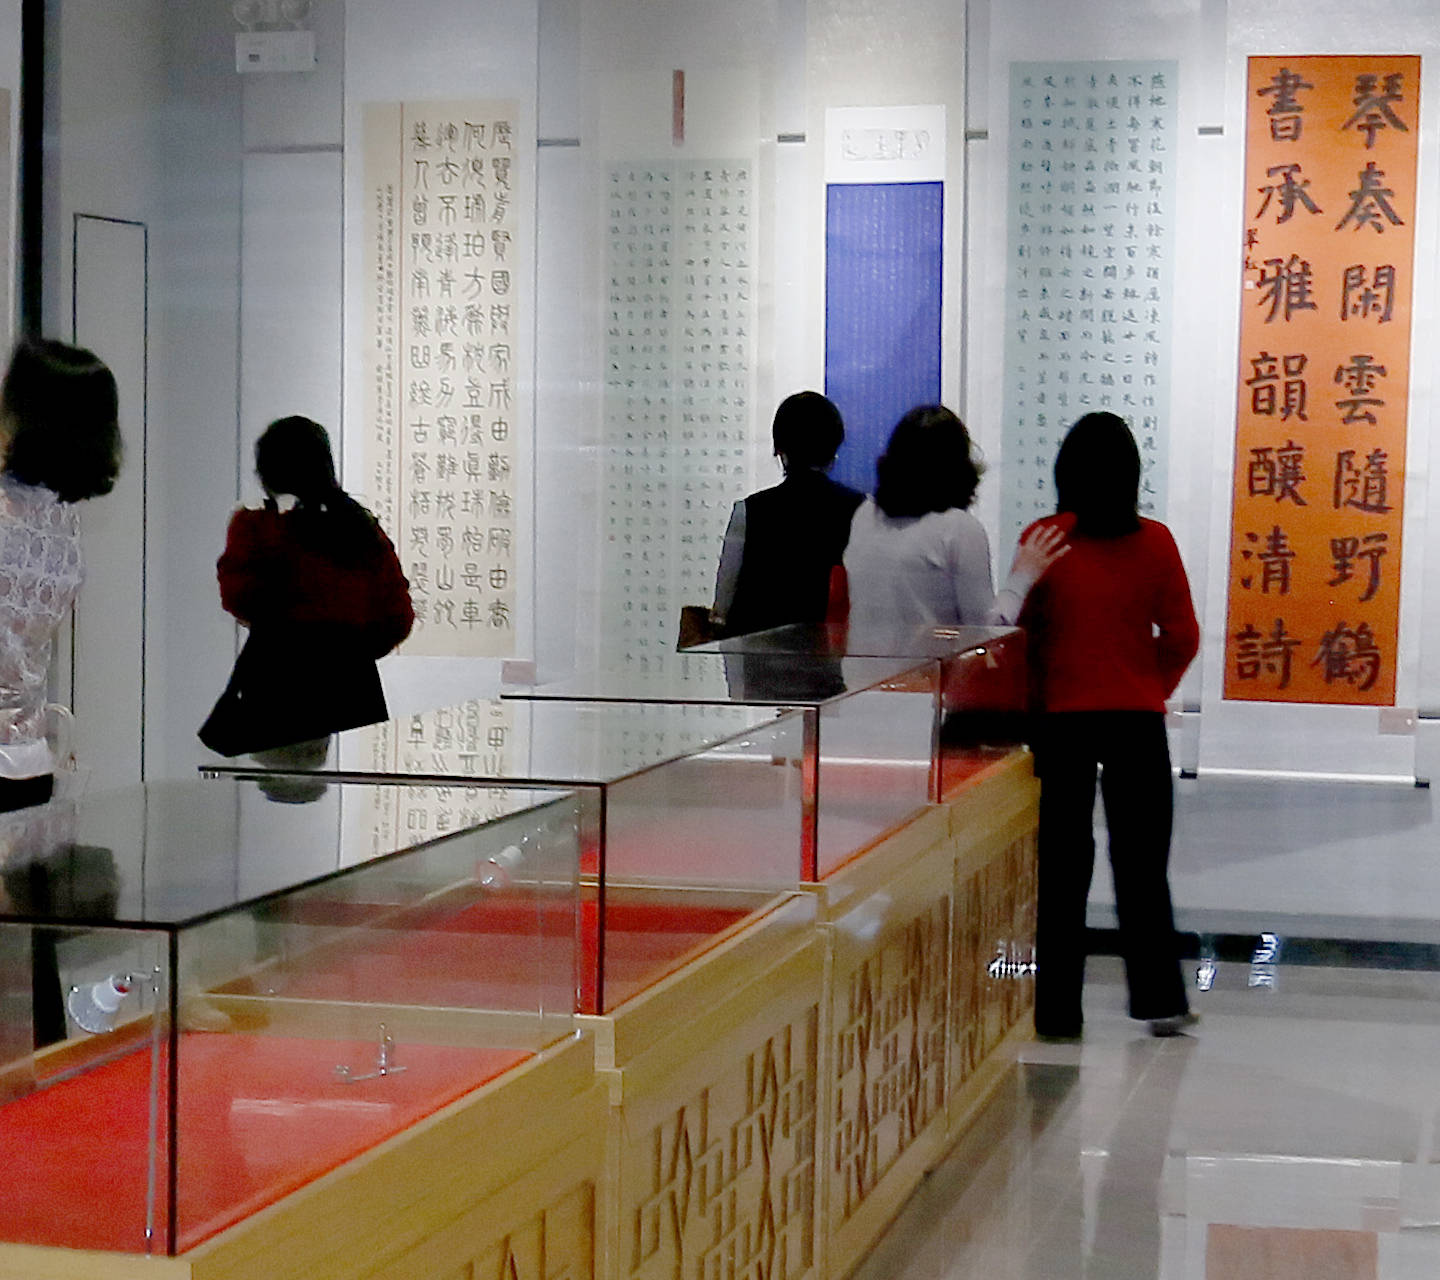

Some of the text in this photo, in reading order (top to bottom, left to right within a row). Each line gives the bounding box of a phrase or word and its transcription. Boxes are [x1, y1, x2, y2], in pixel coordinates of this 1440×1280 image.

[1234, 67, 1323, 691] 書承雅韻釀清詩
